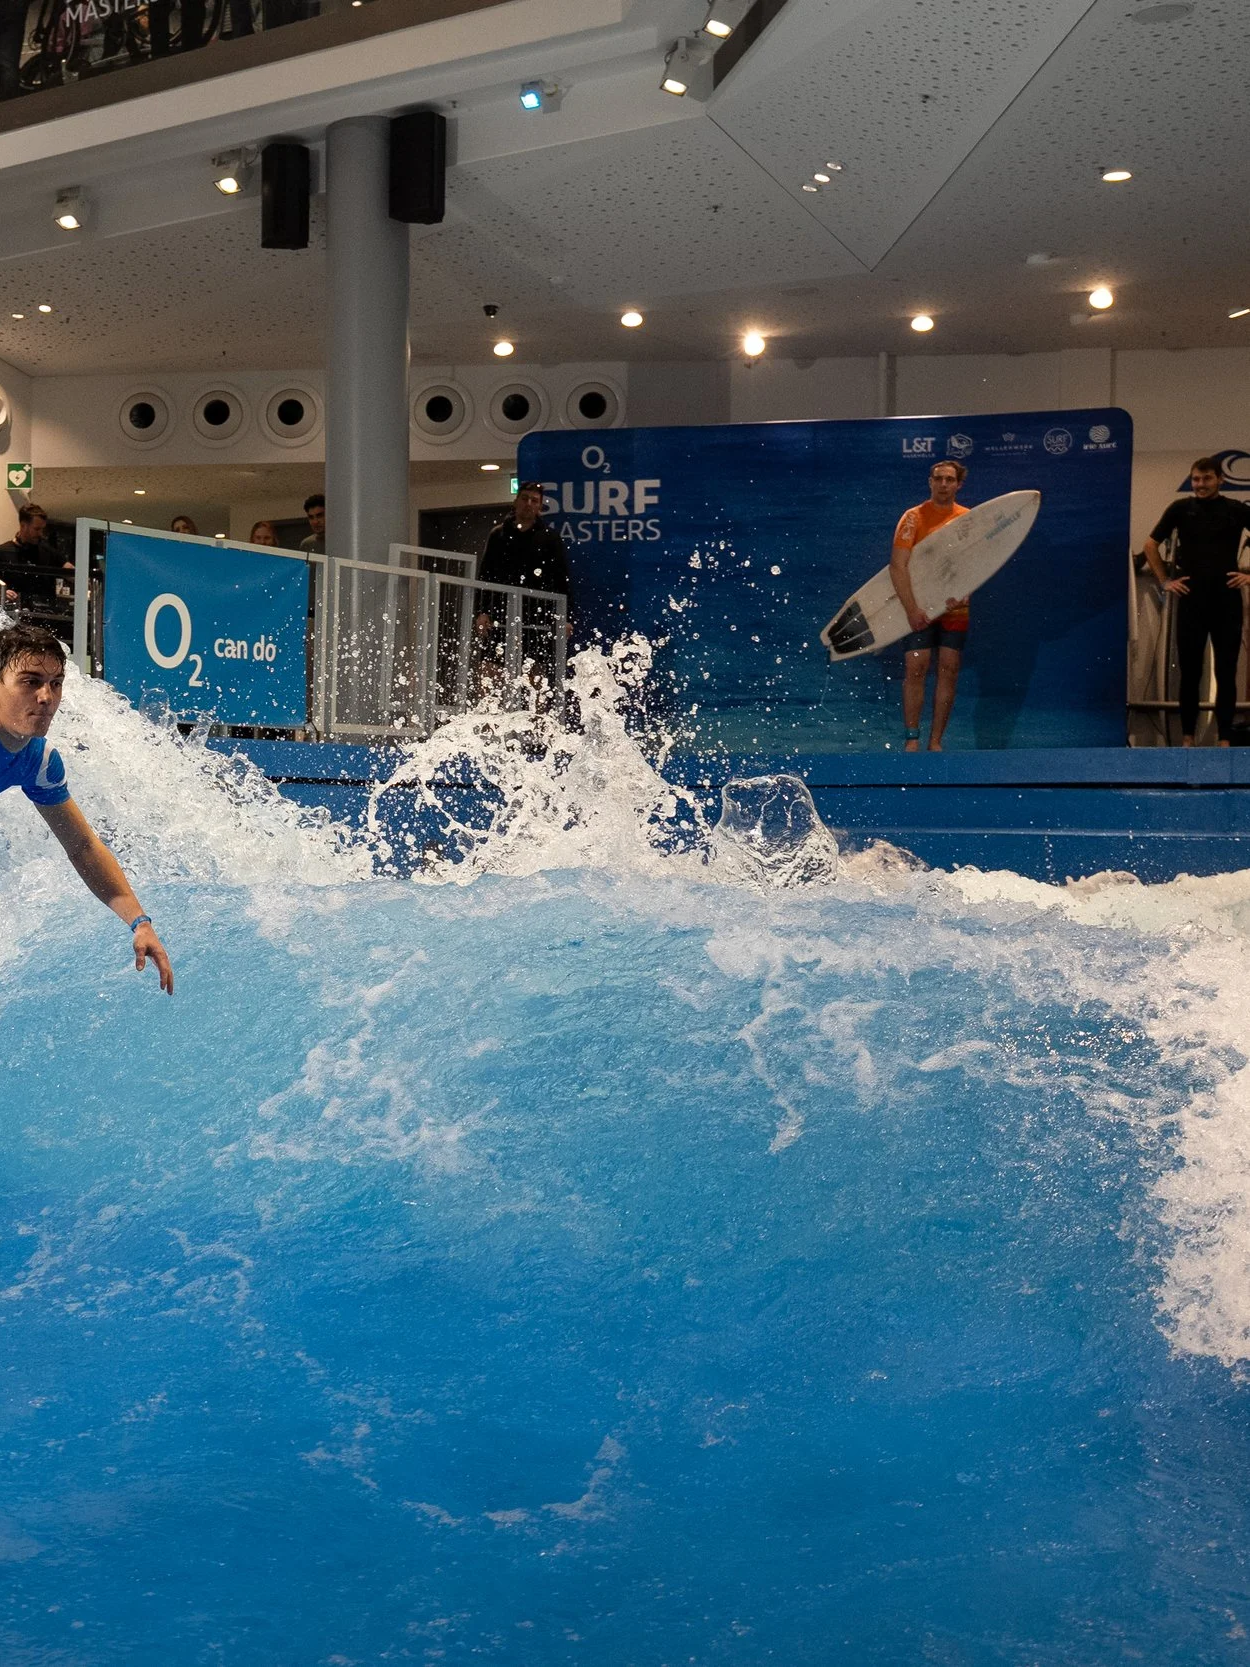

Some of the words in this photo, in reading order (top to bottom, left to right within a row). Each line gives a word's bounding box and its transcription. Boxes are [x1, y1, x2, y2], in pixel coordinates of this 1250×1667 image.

[581, 445, 611, 473] O2
[902, 437, 936, 453] L&T
[540, 479, 661, 516] SURF
[550, 519, 661, 542] ASTERS
[144, 592, 203, 687] O2
[214, 638, 248, 660] can
[253, 634, 277, 662] do
